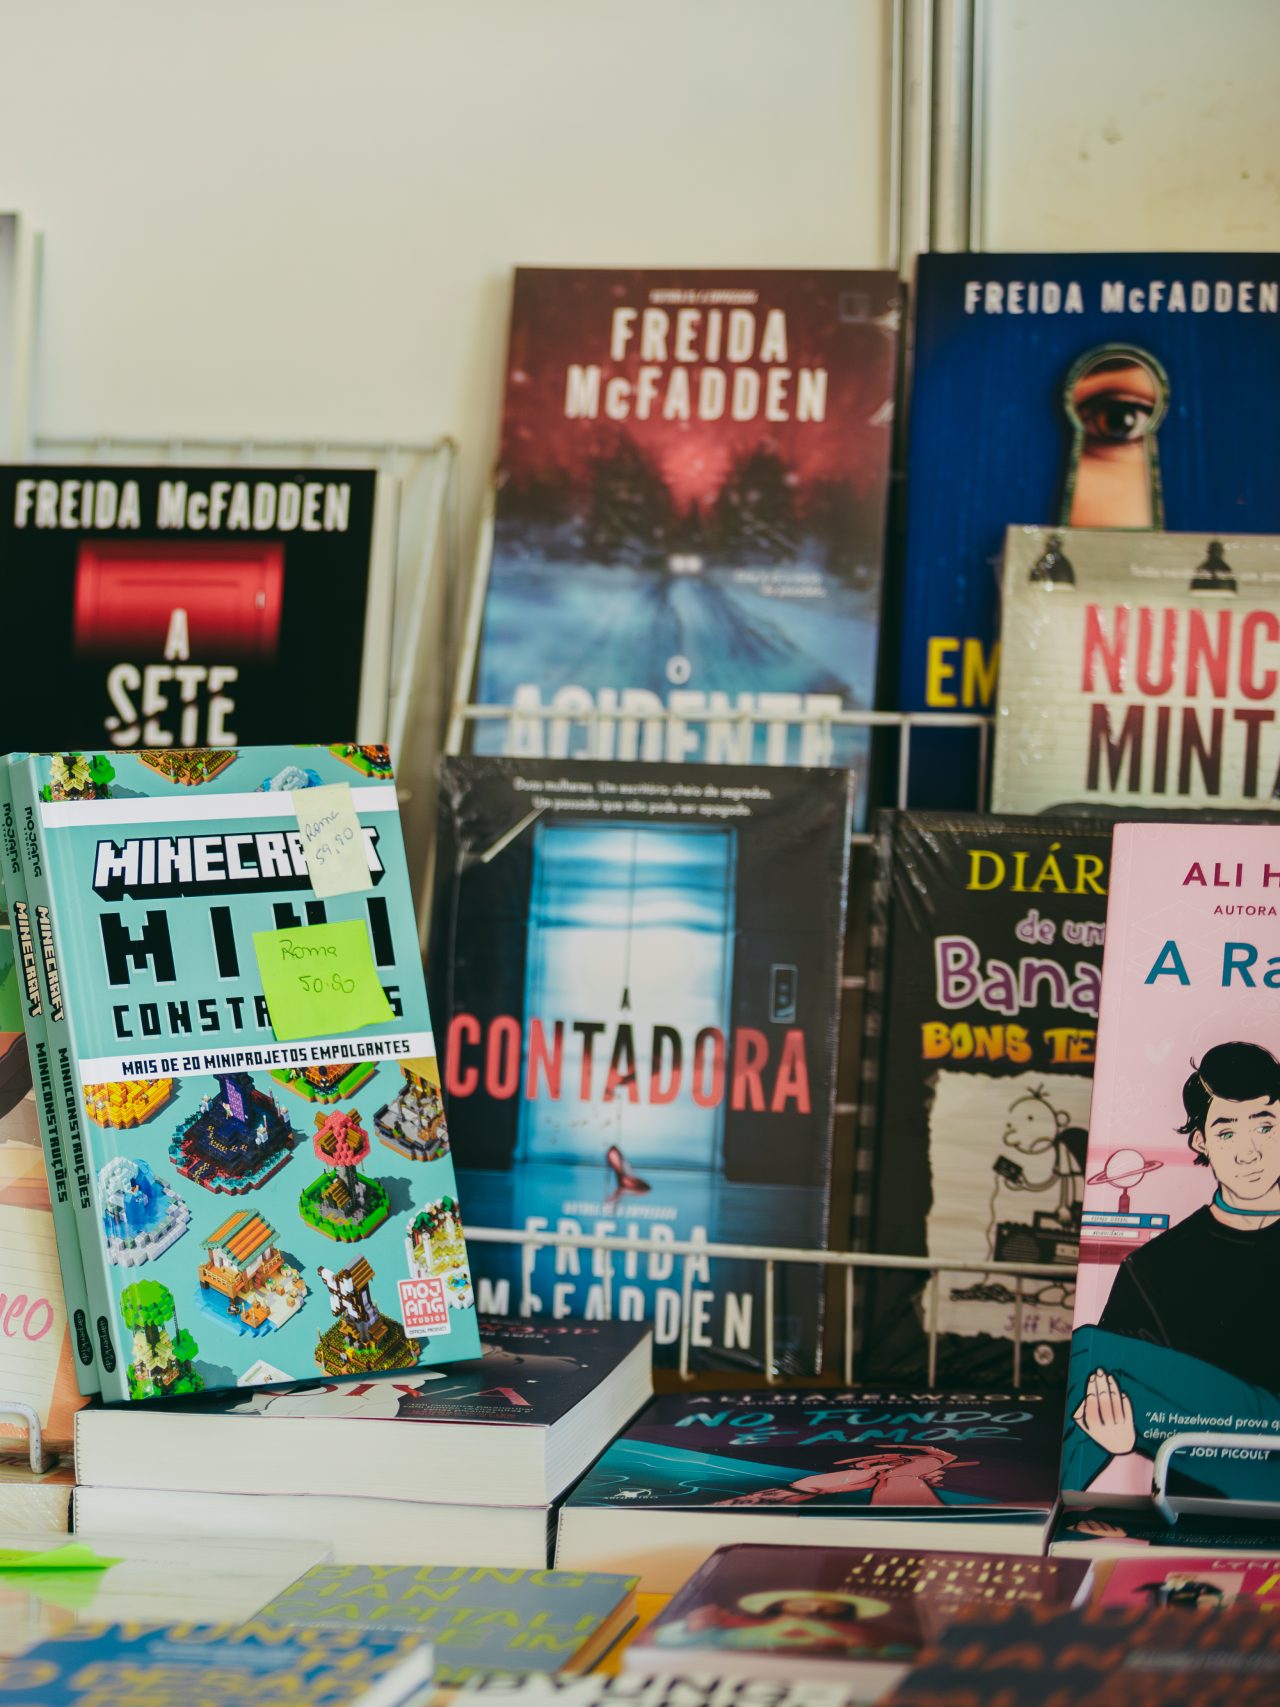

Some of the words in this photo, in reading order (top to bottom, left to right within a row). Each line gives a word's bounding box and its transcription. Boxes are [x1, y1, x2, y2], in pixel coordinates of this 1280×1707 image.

[964, 281, 1084, 314] FREIDA
[1100, 281, 1279, 314] McFADDEN
[609, 307, 788, 363] FREIDA
[564, 363, 829, 423] McFADDEN
[14, 480, 141, 529] FREIDA
[156, 481, 352, 532] McFADDEN
[163, 607, 190, 661] A
[104, 663, 239, 749] SETE
[1086, 703, 1280, 802] MINT
[93, 826, 384, 899] MINECRAT
[965, 842, 1108, 896] DIÁR
[1182, 862, 1244, 887] ALI
[1015, 908, 1056, 944] de
[1214, 905, 1277, 916] AUTORA
[15, 901, 43, 1018] MINECRAFT
[36, 905, 66, 1023] MINECRAFT
[280, 939, 338, 961] Roma
[1144, 940, 1191, 986] A
[112, 985, 404, 1038] CONSTRS
[122, 1059, 158, 1076] MAIS
[162, 1057, 179, 1073] DE
[183, 1056, 200, 1071] 20
[204, 1045, 308, 1070] MINIPROJETOS
[311, 1039, 411, 1060] EMPOLGANTES
[445, 1013, 813, 1115] CONTADORA
[921, 1021, 1032, 1063] BONS
[35, 1042, 69, 1204] MINICONSTRUÇÕES
[58, 1047, 91, 1210] MINICONSTRUÇÕES
[522, 1217, 711, 1283] FREIDA
[675, 1409, 776, 1428] NO
[803, 1408, 1035, 1428] FUNDO
[797, 1426, 1024, 1446] AMOR
[1168, 1412, 1233, 1427] Hazelwood
[1235, 1419, 1268, 1430] prova
[1190, 1447, 1217, 1457] JODI
[1221, 1448, 1271, 1460] PICOULT
